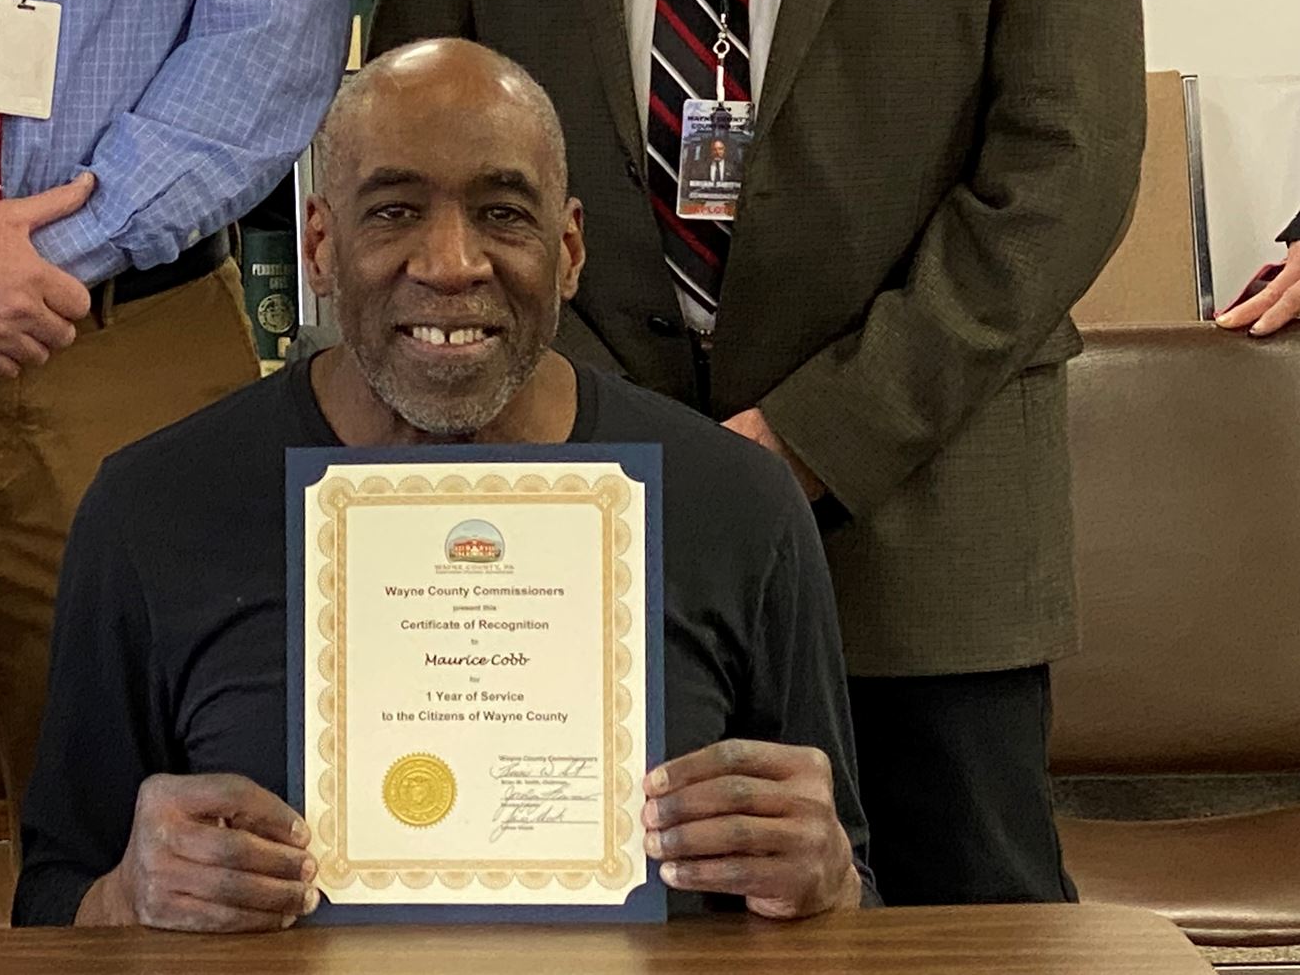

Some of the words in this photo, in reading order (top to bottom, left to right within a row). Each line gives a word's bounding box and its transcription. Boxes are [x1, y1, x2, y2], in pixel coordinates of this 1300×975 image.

[385, 586, 424, 599] Wayne
[428, 585, 470, 599] County
[473, 585, 564, 597] Commissioners
[453, 605, 481, 613] present
[483, 604, 497, 612] this
[400, 619, 460, 631] Certificate
[463, 619, 476, 631] of
[478, 620, 549, 633] Recognition
[470, 637, 479, 646] to
[424, 652, 490, 667] Maurice
[491, 652, 530, 666] Cobb
[469, 676, 481, 684] for
[426, 692, 432, 702] 1
[435, 691, 462, 702] Year
[465, 691, 478, 702] of
[481, 691, 525, 702] Service
[382, 711, 394, 722] to
[397, 711, 415, 722] the
[418, 711, 465, 722] Citizens
[468, 711, 480, 722] of
[483, 711, 523, 724] Wayne
[526, 711, 568, 724] County
[499, 754, 522, 762] Wayne
[523, 755, 546, 763] County
